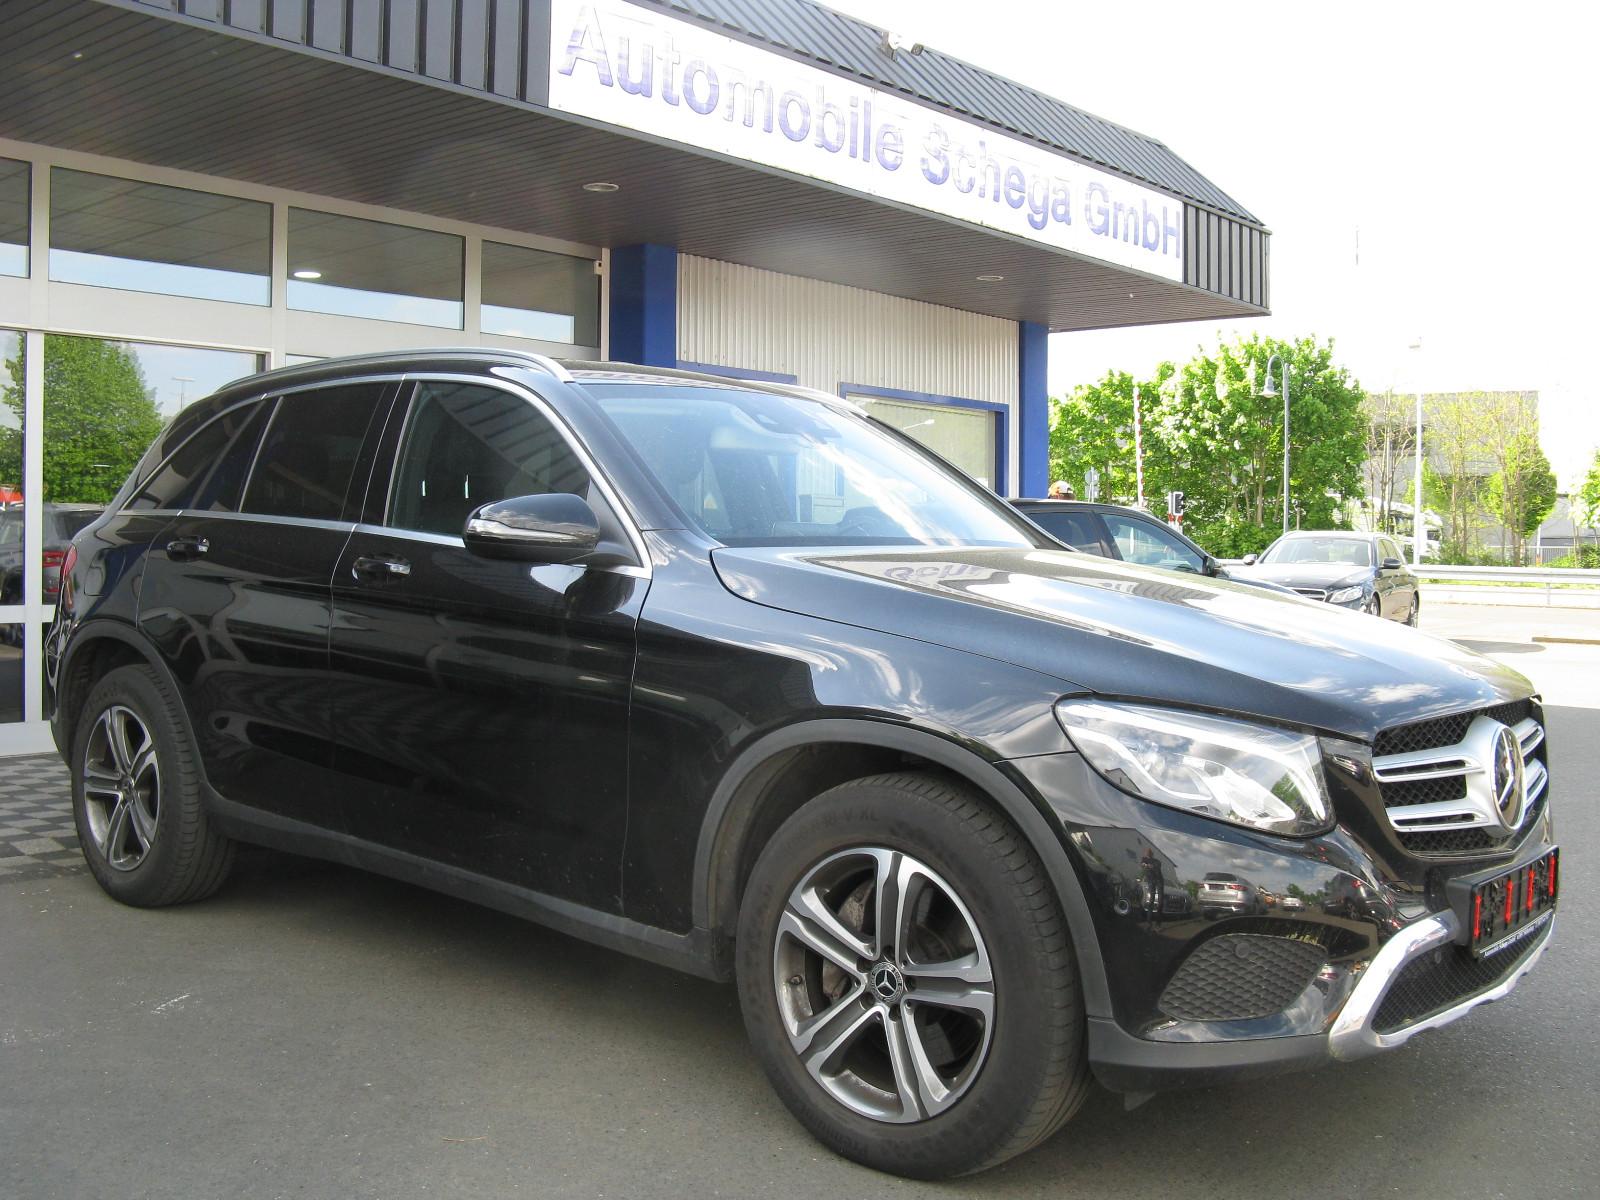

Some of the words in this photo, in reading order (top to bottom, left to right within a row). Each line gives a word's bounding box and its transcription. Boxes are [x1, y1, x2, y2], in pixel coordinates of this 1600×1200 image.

[558, 4, 905, 171] Automobile
[920, 122, 1072, 231] Schega
[1084, 181, 1181, 259] GmbH
